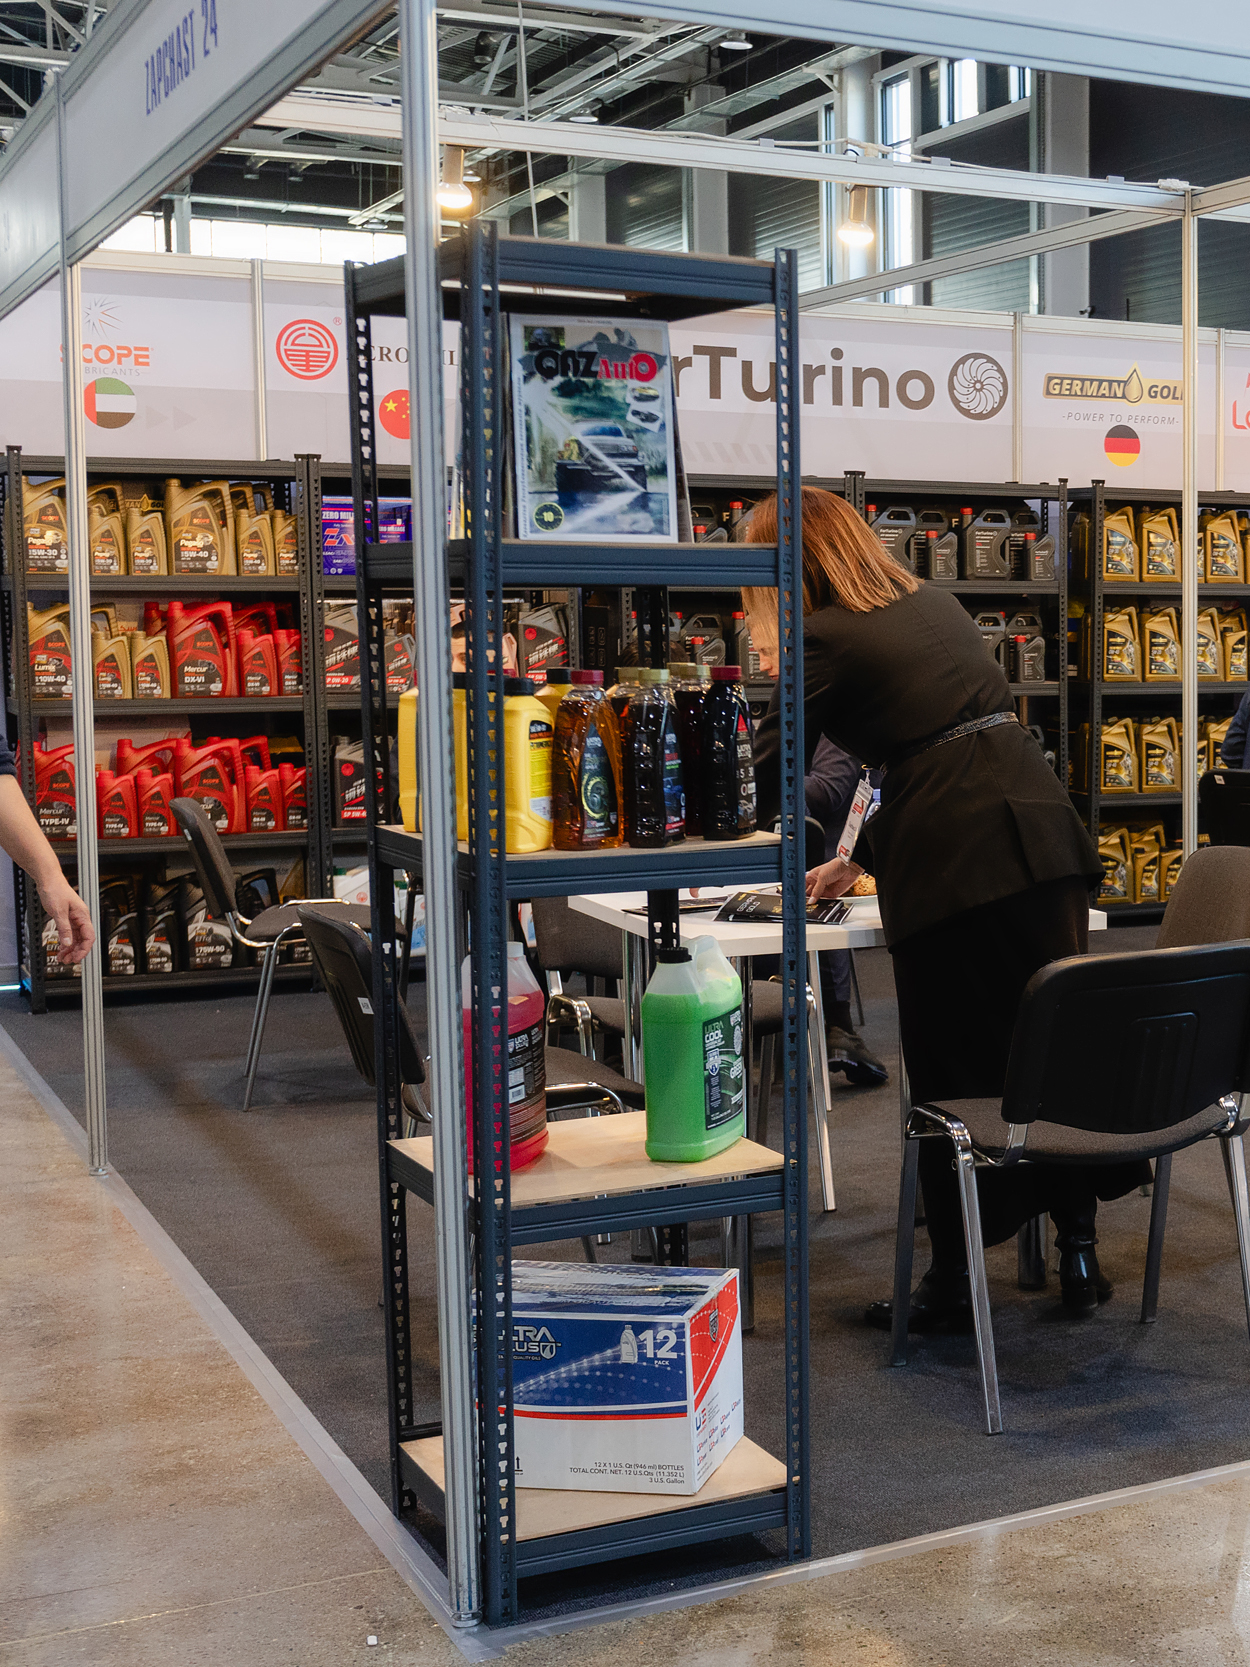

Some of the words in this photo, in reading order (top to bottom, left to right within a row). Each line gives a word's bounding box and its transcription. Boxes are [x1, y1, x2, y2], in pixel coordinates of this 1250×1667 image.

[145, 9, 195, 116] ZAPCHAST
[201, 0, 217, 57] 24
[84, 366, 141, 377] BRICANTS
[671, 345, 935, 411] rTurino
[1048, 378, 1125, 398] GERMAN
[1147, 384, 1184, 401] GOL
[1110, 413, 1123, 423] TO
[639, 1329, 678, 1359] 12
